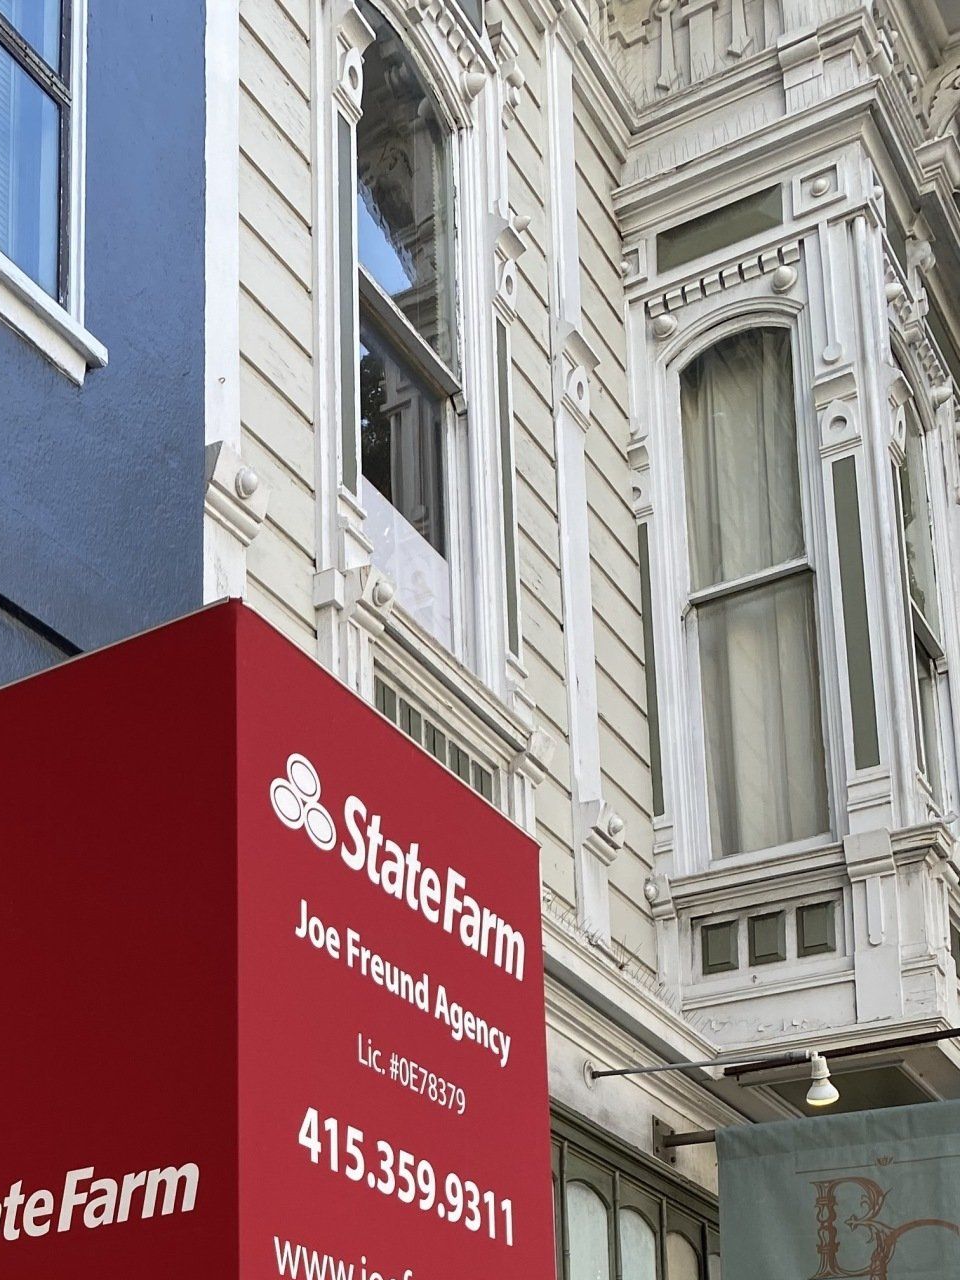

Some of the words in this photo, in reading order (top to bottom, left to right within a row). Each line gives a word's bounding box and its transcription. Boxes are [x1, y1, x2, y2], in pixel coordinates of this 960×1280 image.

[294, 898, 341, 960] Joe
[346, 927, 430, 1013] Freund
[434, 984, 512, 1068] Agency
[358, 1032, 386, 1075] Lic.
[298, 1106, 513, 1247] 415.359.9311
